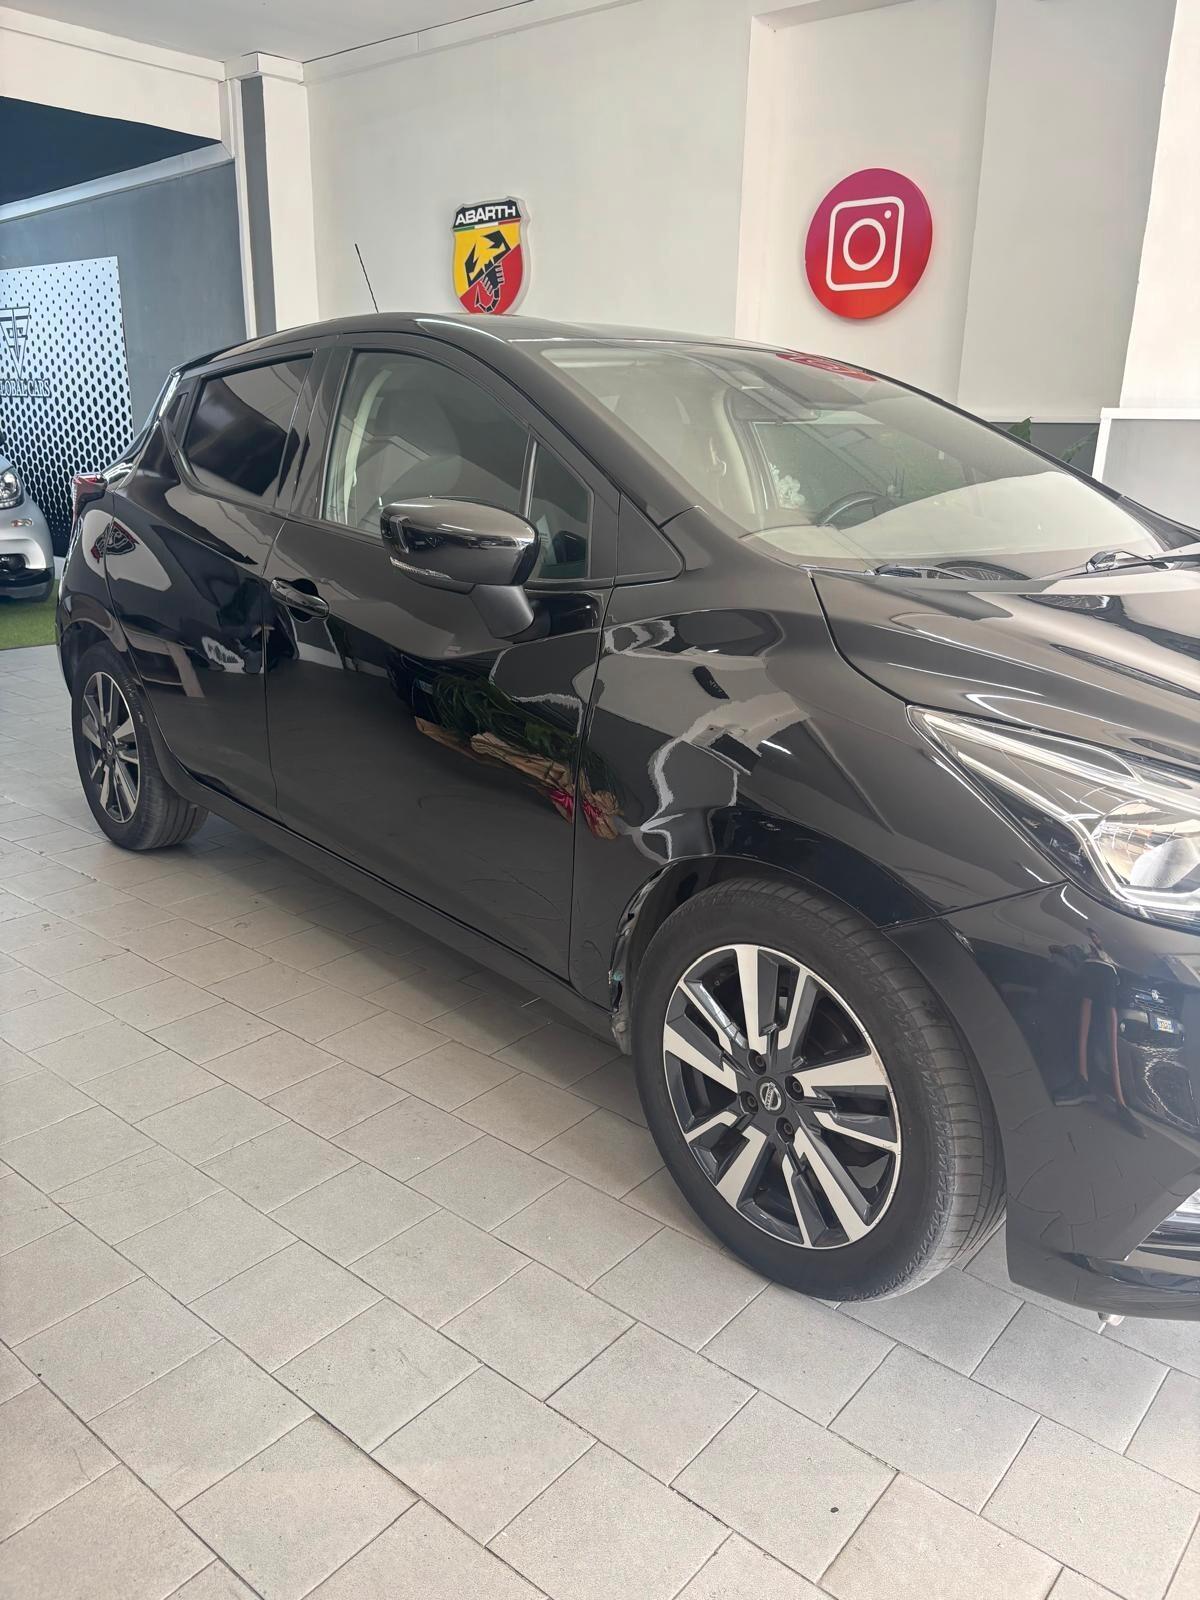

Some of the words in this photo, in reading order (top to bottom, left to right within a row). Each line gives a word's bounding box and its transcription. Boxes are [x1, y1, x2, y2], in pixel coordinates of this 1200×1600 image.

[455, 206, 516, 226] ABARTH
[0, 380, 28, 397] LOBAL
[28, 380, 51, 397] CARS
